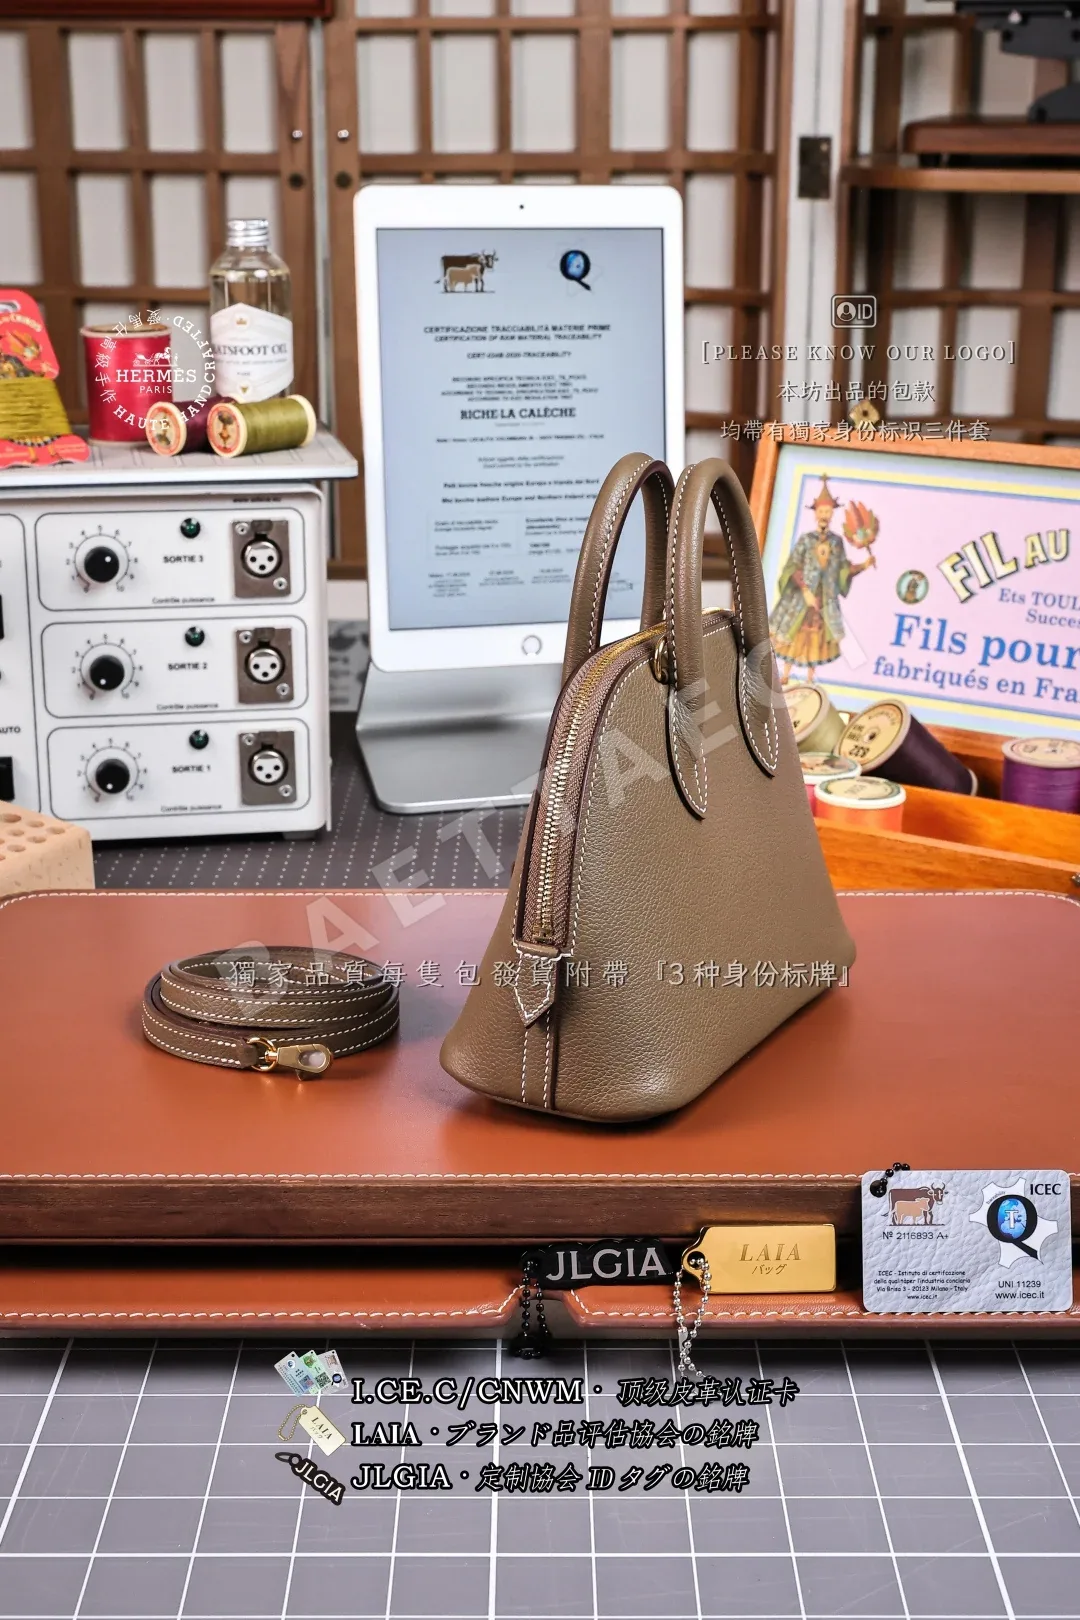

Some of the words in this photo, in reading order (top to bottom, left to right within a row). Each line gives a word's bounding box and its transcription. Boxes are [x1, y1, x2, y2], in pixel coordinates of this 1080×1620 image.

[587, 323, 611, 331] PRIME
[460, 409, 498, 420] RICHE
[500, 408, 516, 419] LA
[163, 554, 196, 564] SORTIE
[936, 530, 1018, 605] FIL
[1024, 527, 1071, 570] AU
[998, 587, 1026, 605] Ets
[890, 612, 968, 655] Fils
[978, 632, 1080, 670] pour
[168, 662, 200, 671] SORTIE
[873, 655, 989, 689] fabriqués
[996, 677, 1026, 696] en
[1032, 676, 1080, 704] Fra
[172, 764, 203, 773] SORTIE
[1029, 1183, 1062, 1196] ICEC
[896, 1231, 934, 1240] 2116893
[936, 1231, 949, 1240] A+
[738, 1242, 802, 1262] LAIA
[546, 1246, 667, 1282] JLGIA
[751, 1263, 788, 1276] バッグ
[998, 1280, 1014, 1288] UNI
[1017, 1280, 1041, 1288] 11239
[995, 1290, 1045, 1299] www.icec.it
